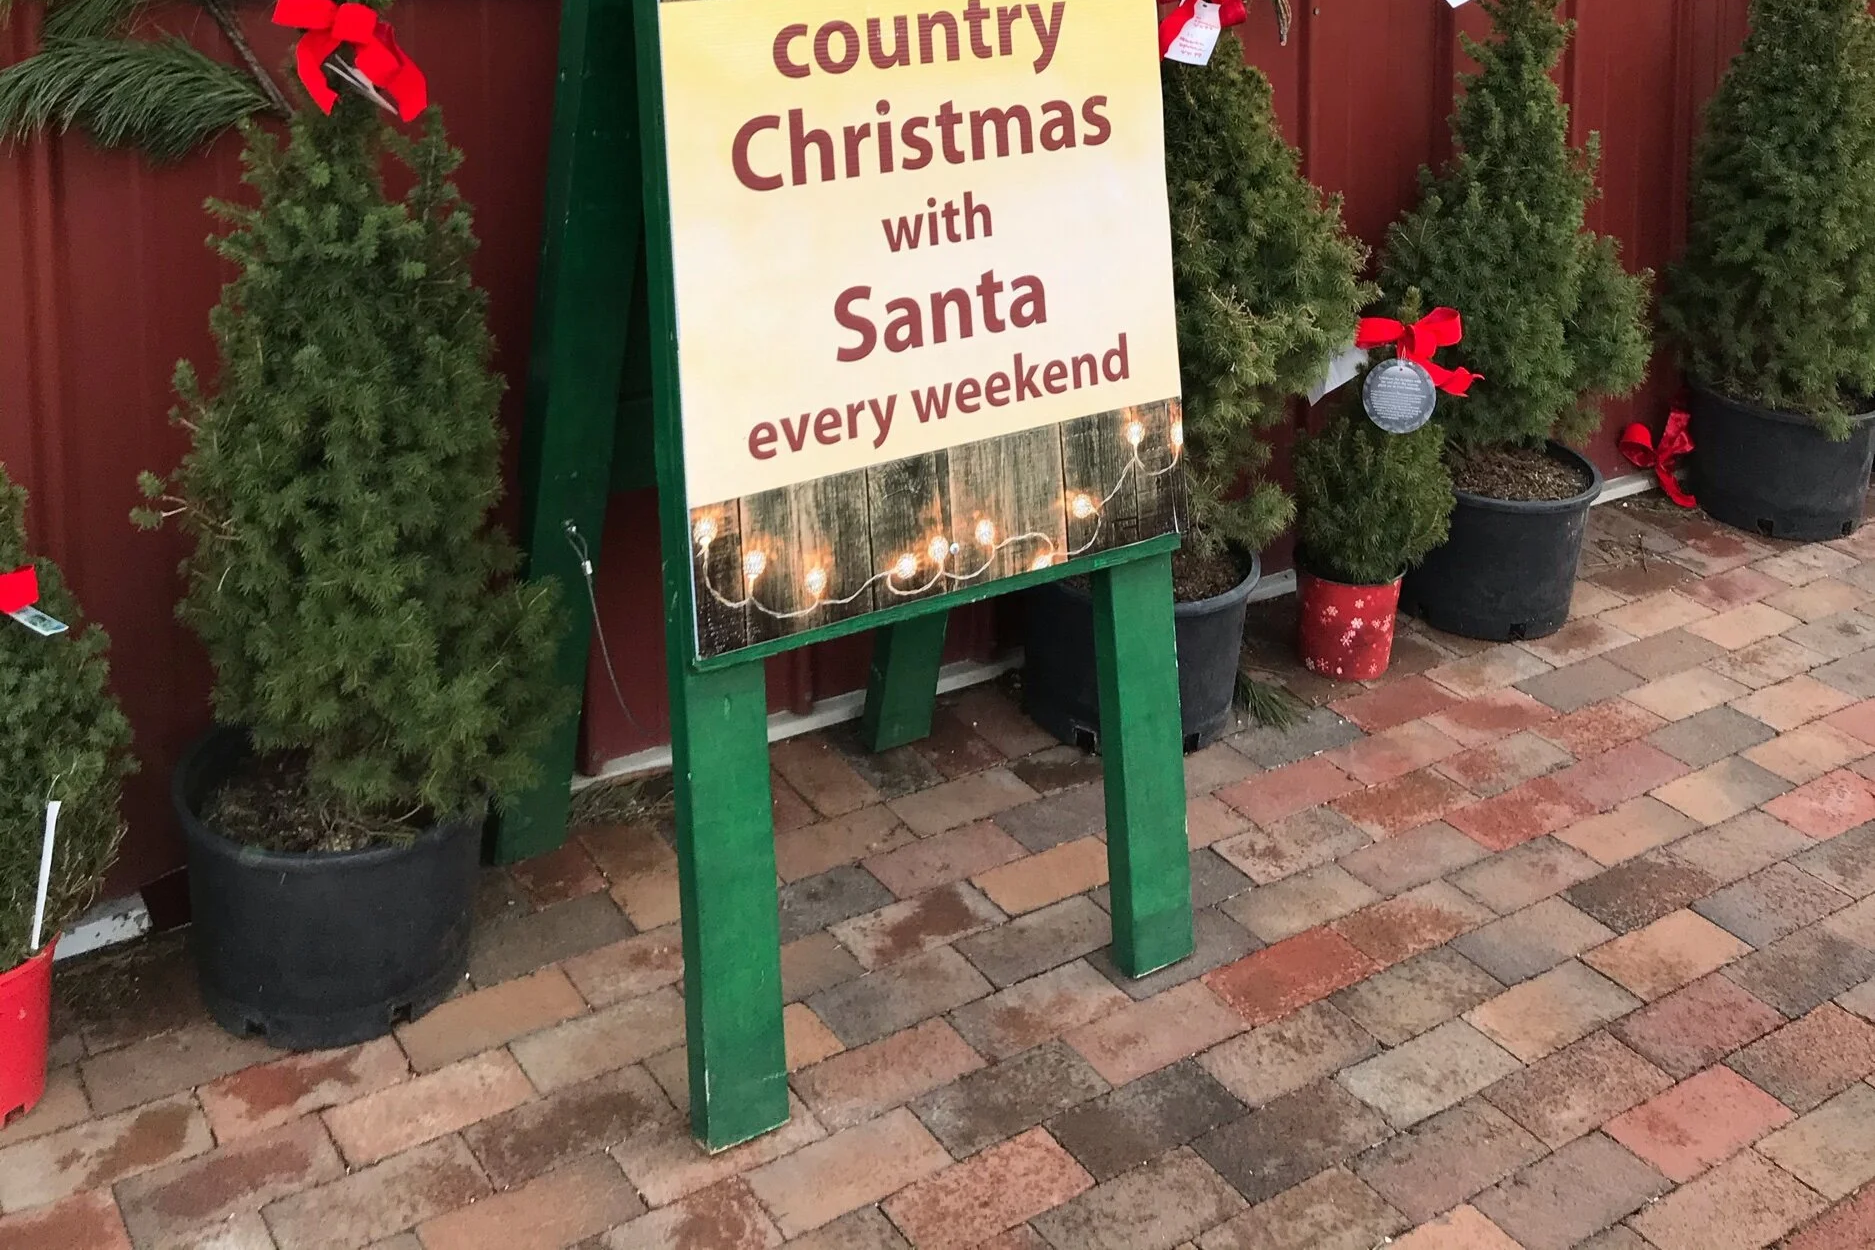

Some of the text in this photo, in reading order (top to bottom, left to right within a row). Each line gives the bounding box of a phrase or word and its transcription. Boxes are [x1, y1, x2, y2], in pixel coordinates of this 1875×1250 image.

[731, 95, 1112, 192] Christmas
[882, 191, 993, 253] with
[833, 269, 1048, 362] Santa
[747, 332, 1131, 461] every weekend
